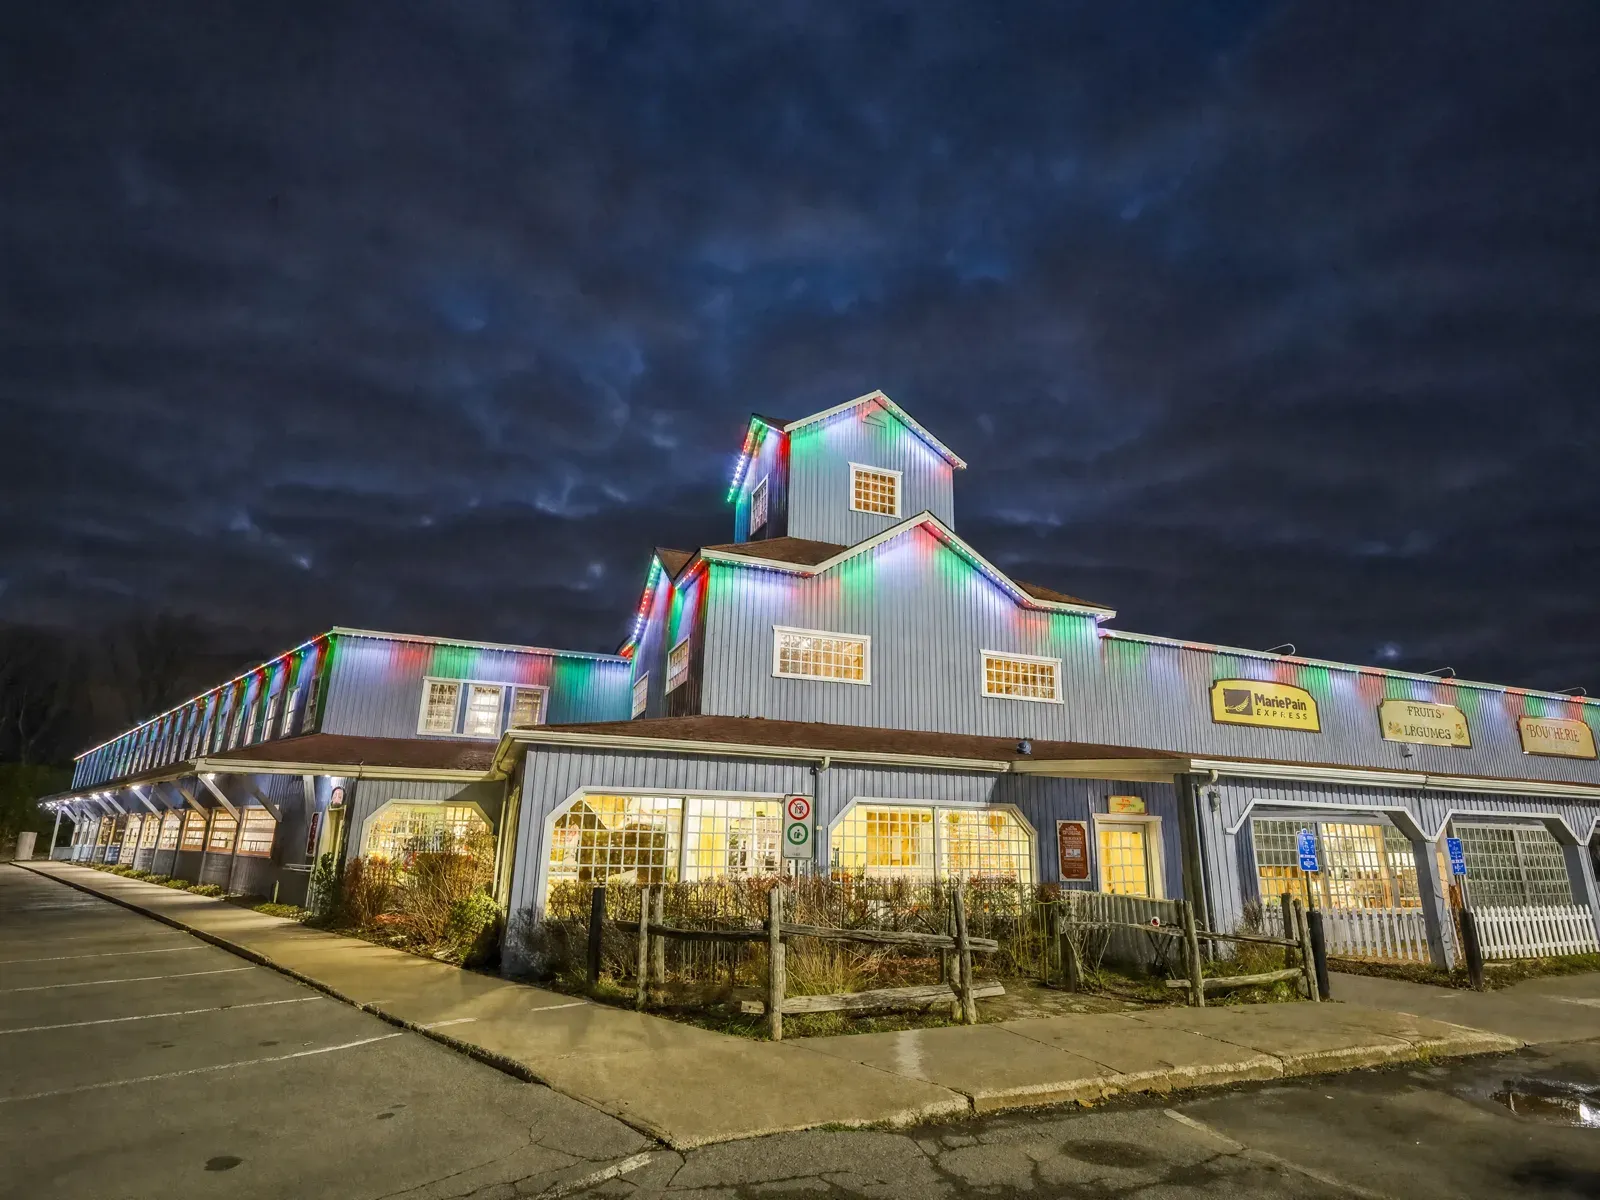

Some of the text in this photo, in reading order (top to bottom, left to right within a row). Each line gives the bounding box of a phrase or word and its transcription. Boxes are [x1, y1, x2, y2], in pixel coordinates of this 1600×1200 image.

[1254, 693, 1307, 711] MariePain
[1256, 709, 1308, 720] EXPRESS
[1407, 705, 1442, 719] FRUITS
